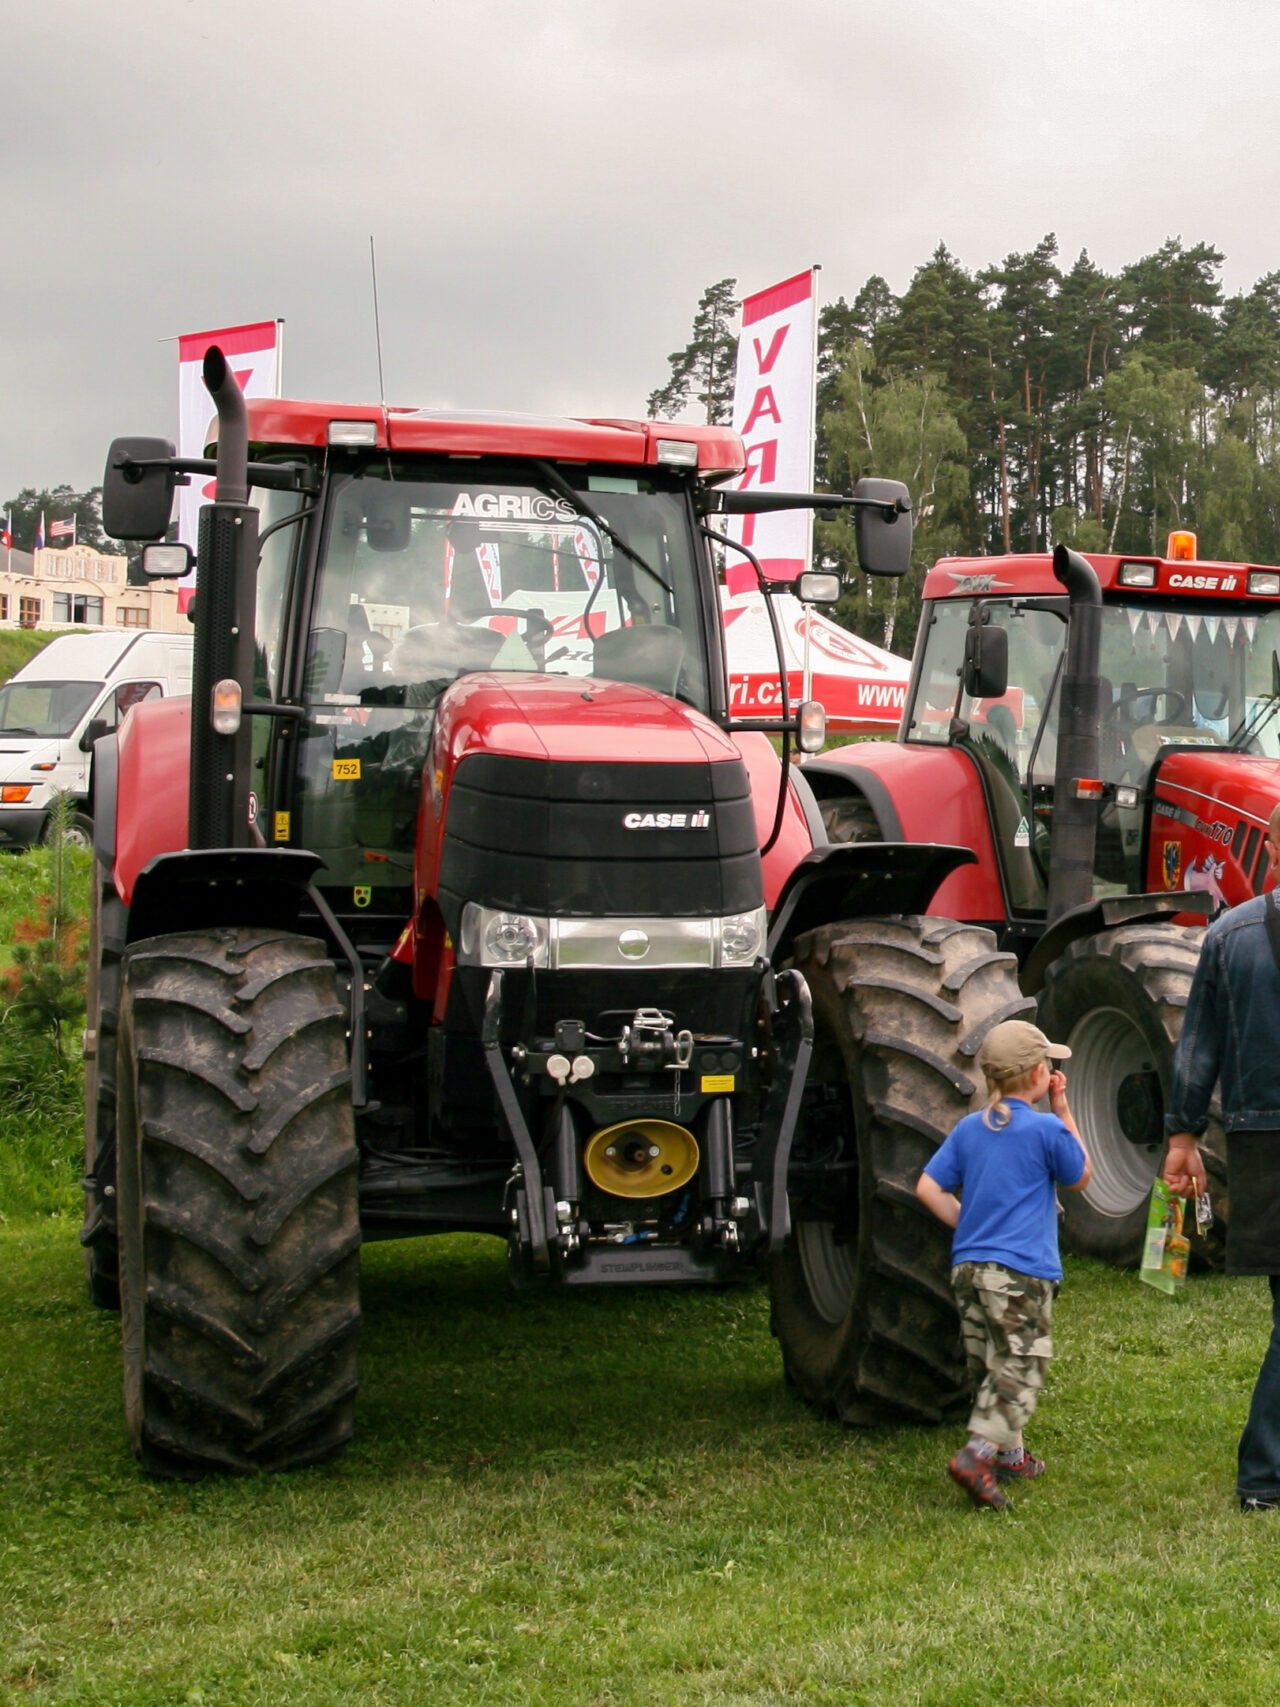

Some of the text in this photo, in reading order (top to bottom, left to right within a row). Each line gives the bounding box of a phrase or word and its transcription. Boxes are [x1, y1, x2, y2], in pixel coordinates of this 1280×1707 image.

[47, 554, 118, 583] HOTEL
[1169, 574, 1217, 589] CASE
[336, 764, 357, 775] 752
[624, 813, 687, 828] CASE
[1209, 821, 1233, 845] 170
